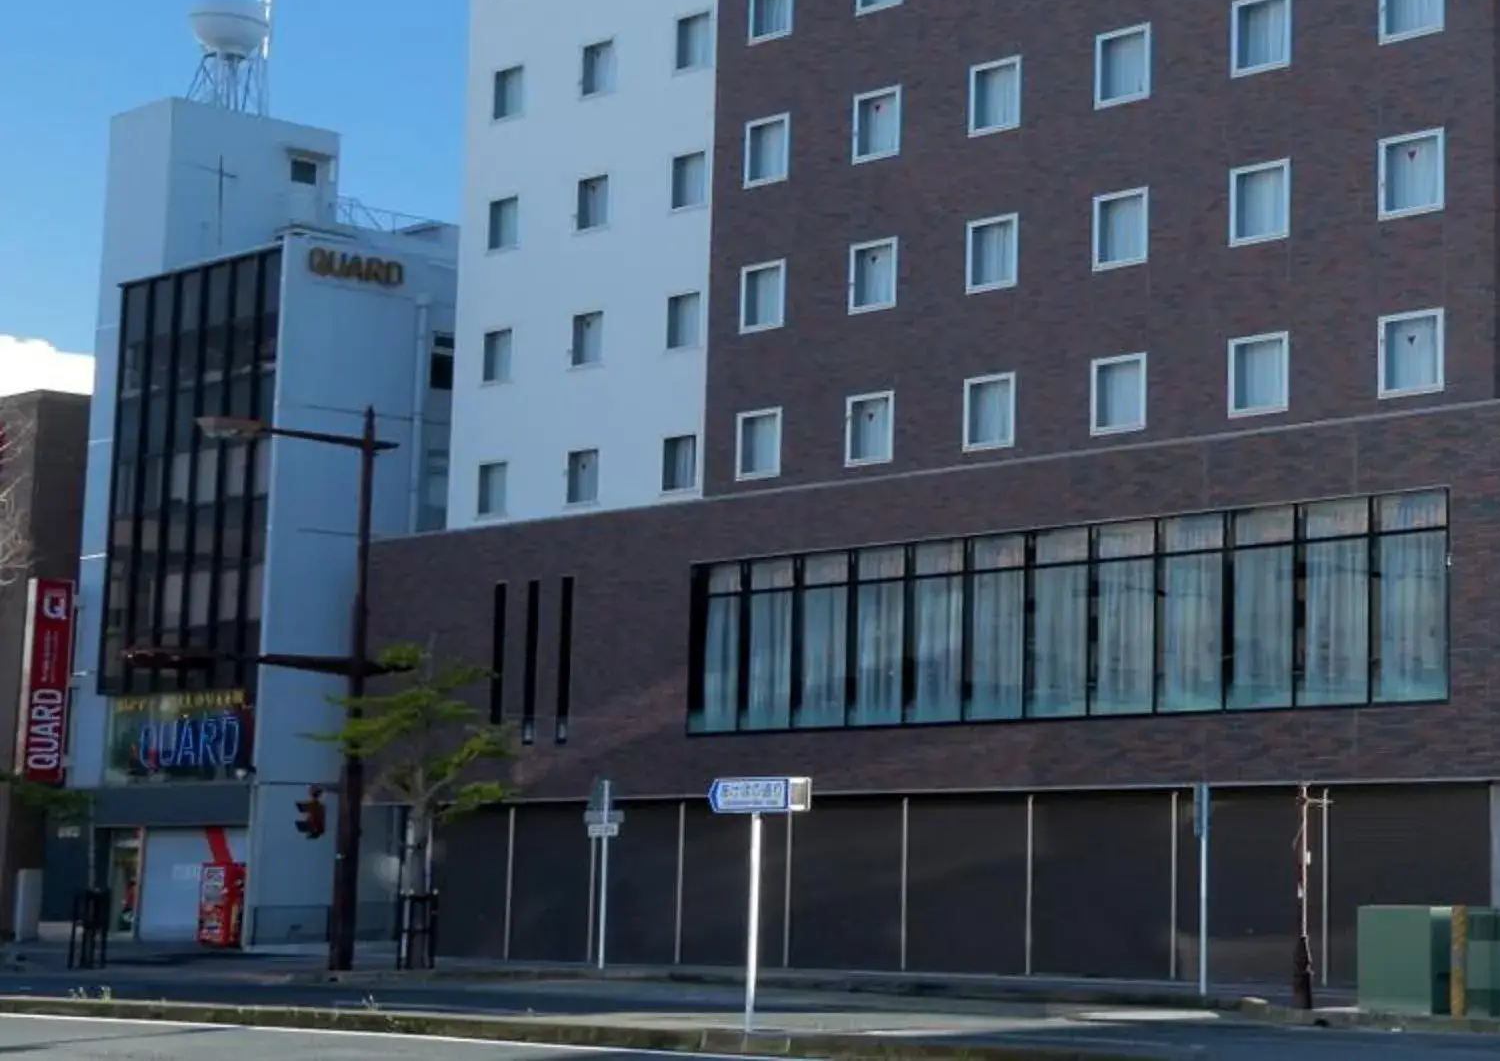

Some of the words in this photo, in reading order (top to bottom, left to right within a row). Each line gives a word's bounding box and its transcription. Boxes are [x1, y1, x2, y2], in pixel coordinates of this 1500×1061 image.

[308, 247, 405, 287] QUARD
[27, 688, 63, 770] QUARD
[139, 715, 240, 769] QUARD
